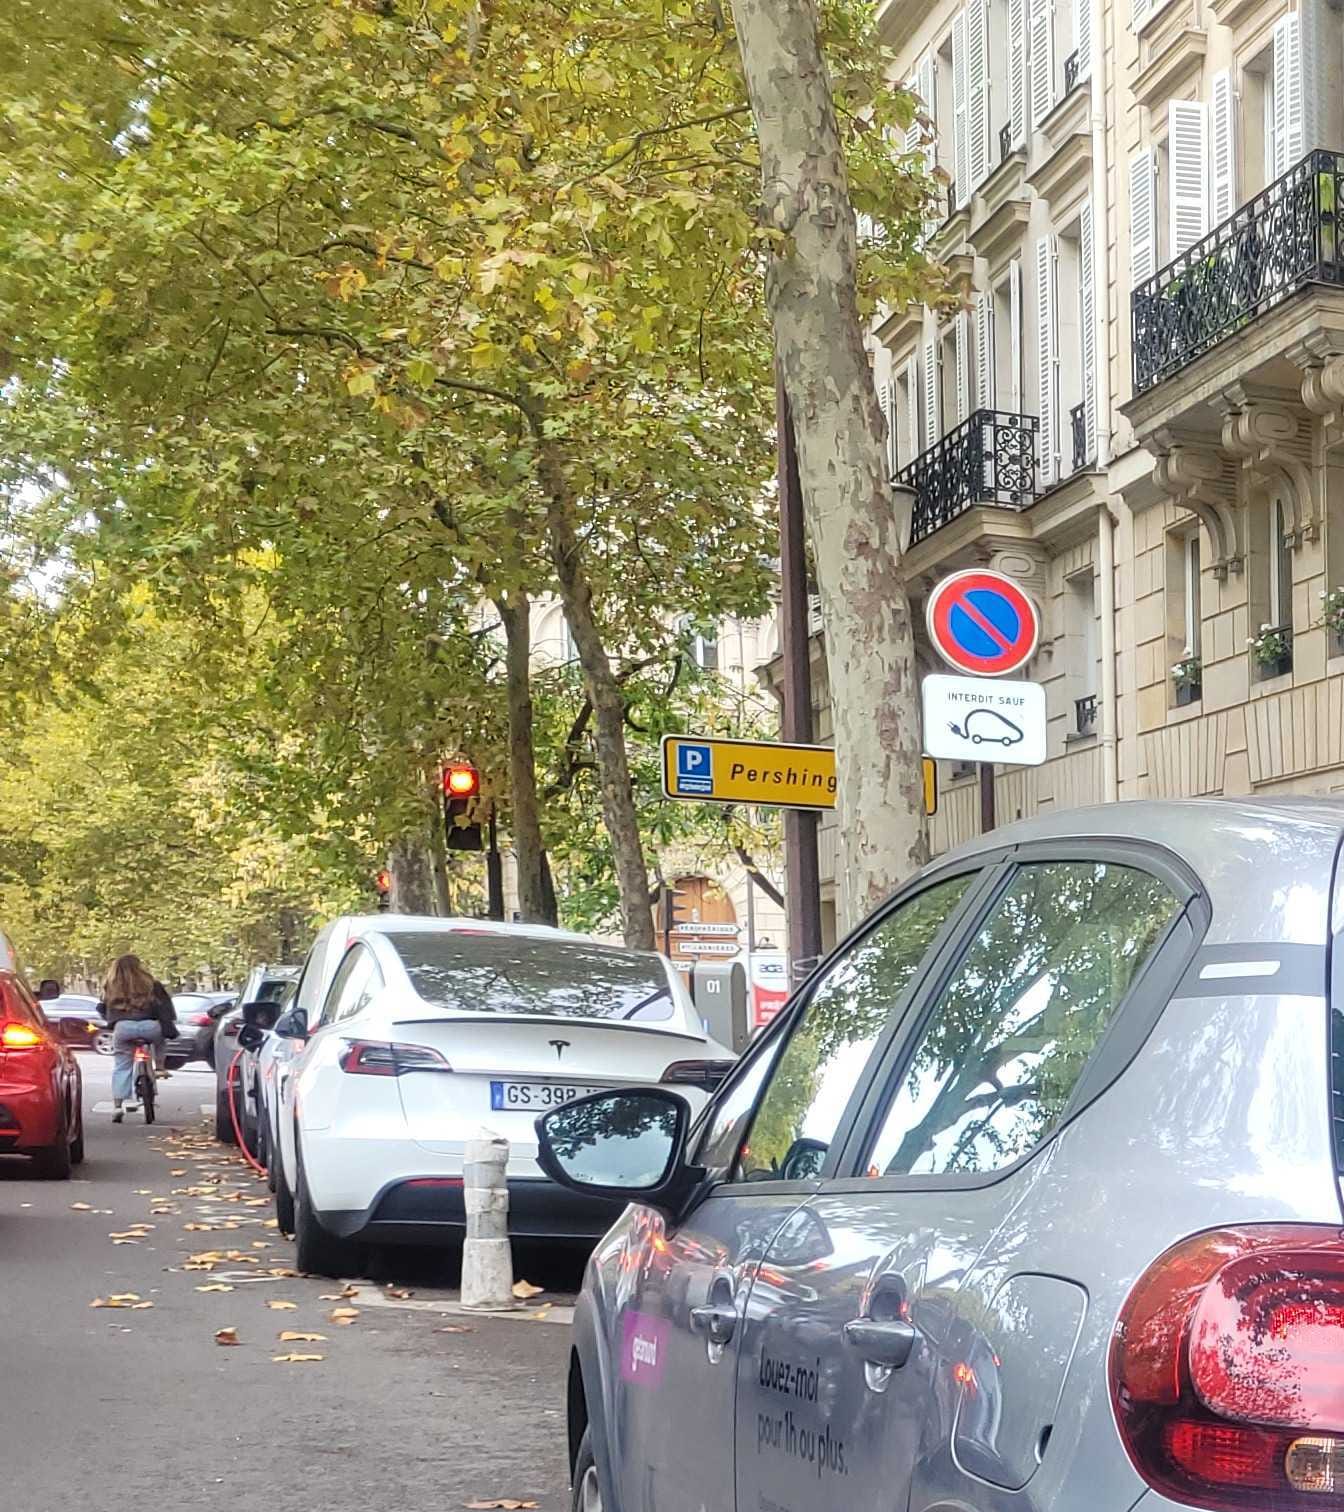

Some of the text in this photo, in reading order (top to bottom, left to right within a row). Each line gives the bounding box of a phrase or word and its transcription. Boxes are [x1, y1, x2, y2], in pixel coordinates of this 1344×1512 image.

[948, 691, 1025, 706] INTERDIT SAUF
[686, 750, 703, 771] P
[730, 763, 838, 793] Pershing
[706, 980, 721, 993] 01
[759, 1344, 821, 1403] Louez-moi
[757, 1411, 782, 1454] pour
[800, 1428, 815, 1462] ou
[818, 1424, 849, 1479] plus.
